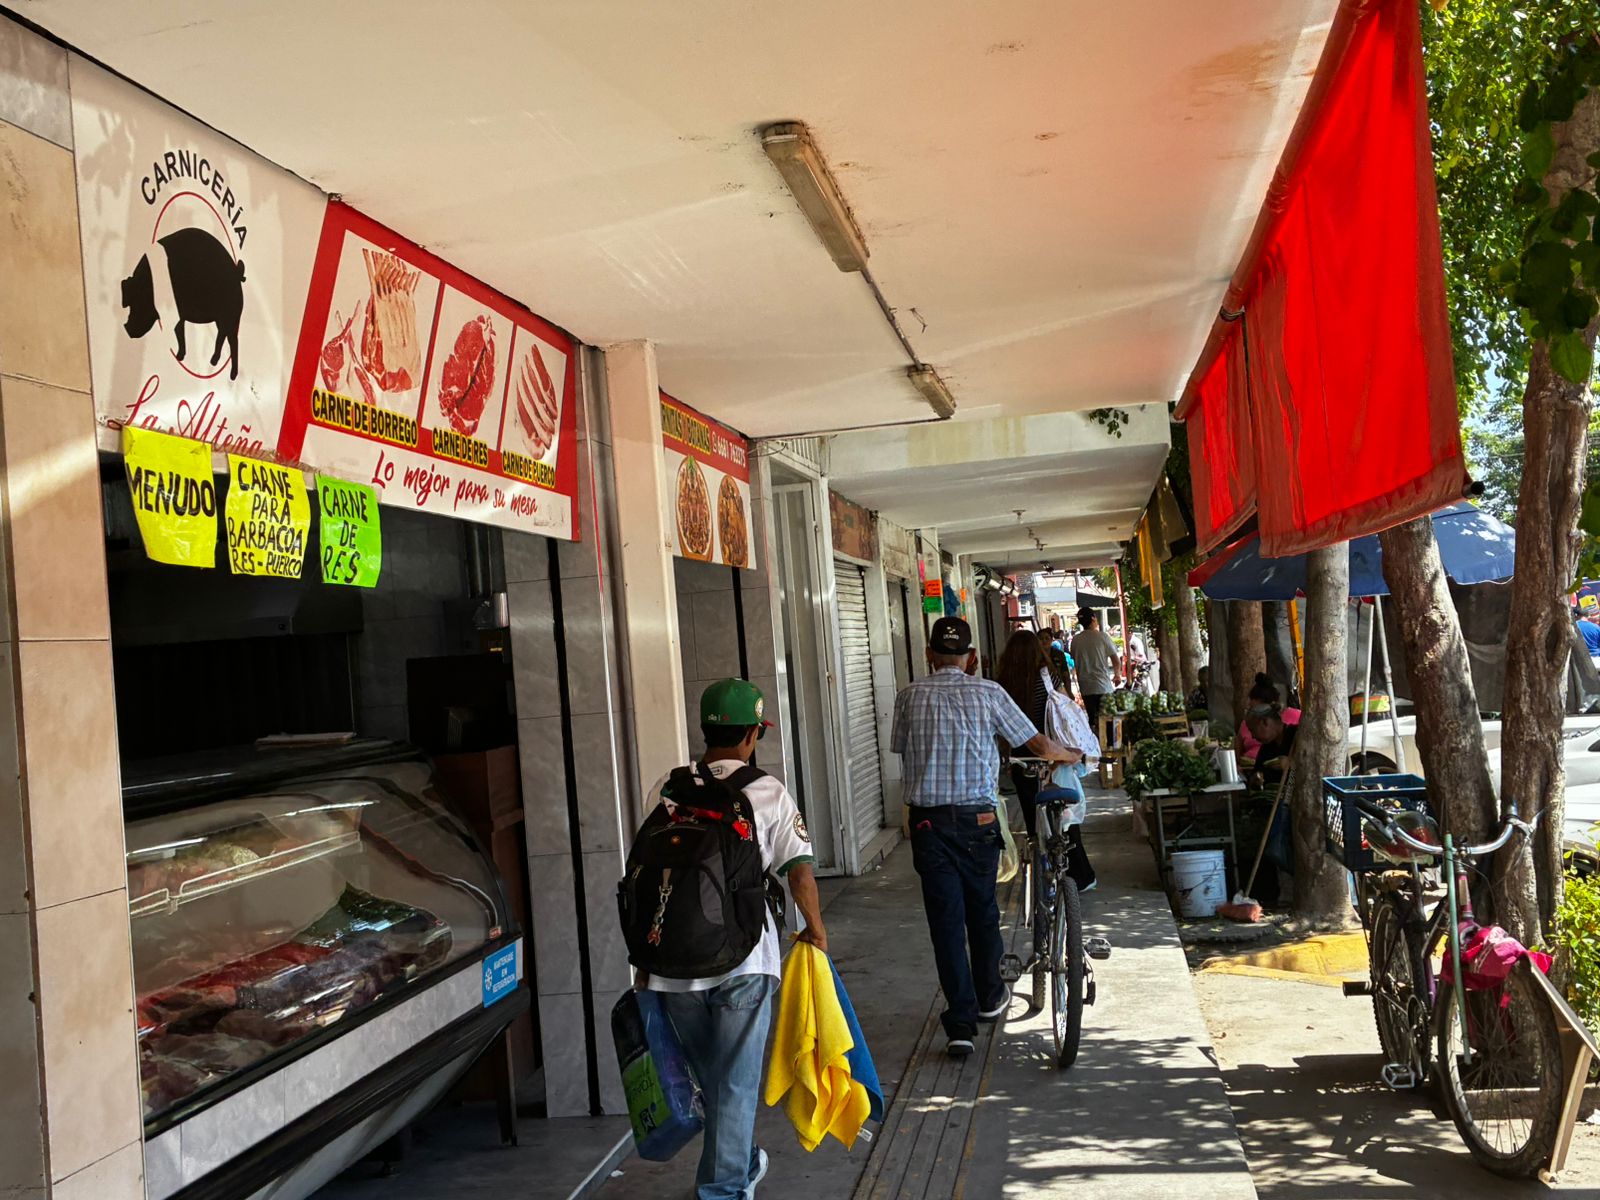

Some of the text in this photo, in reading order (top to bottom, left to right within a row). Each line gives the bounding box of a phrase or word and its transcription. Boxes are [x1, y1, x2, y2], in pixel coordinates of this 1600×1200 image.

[312, 389, 418, 446] CARNE DE BORREGO
[432, 427, 488, 466] CARNE DE RES
[237, 461, 295, 501] CARNE
[372, 449, 538, 517] Lo mejor para su mesa
[503, 450, 556, 486] CARNE DE PUERCO
[126, 462, 216, 518] MENUDO
[250, 494, 291, 525] PARA
[322, 485, 368, 523] CARNE
[228, 517, 303, 557] BARBACOA
[339, 523, 357, 550] DE
[232, 549, 256, 574] RES
[266, 553, 302, 577] PUERCO
[324, 545, 361, 584] RES
